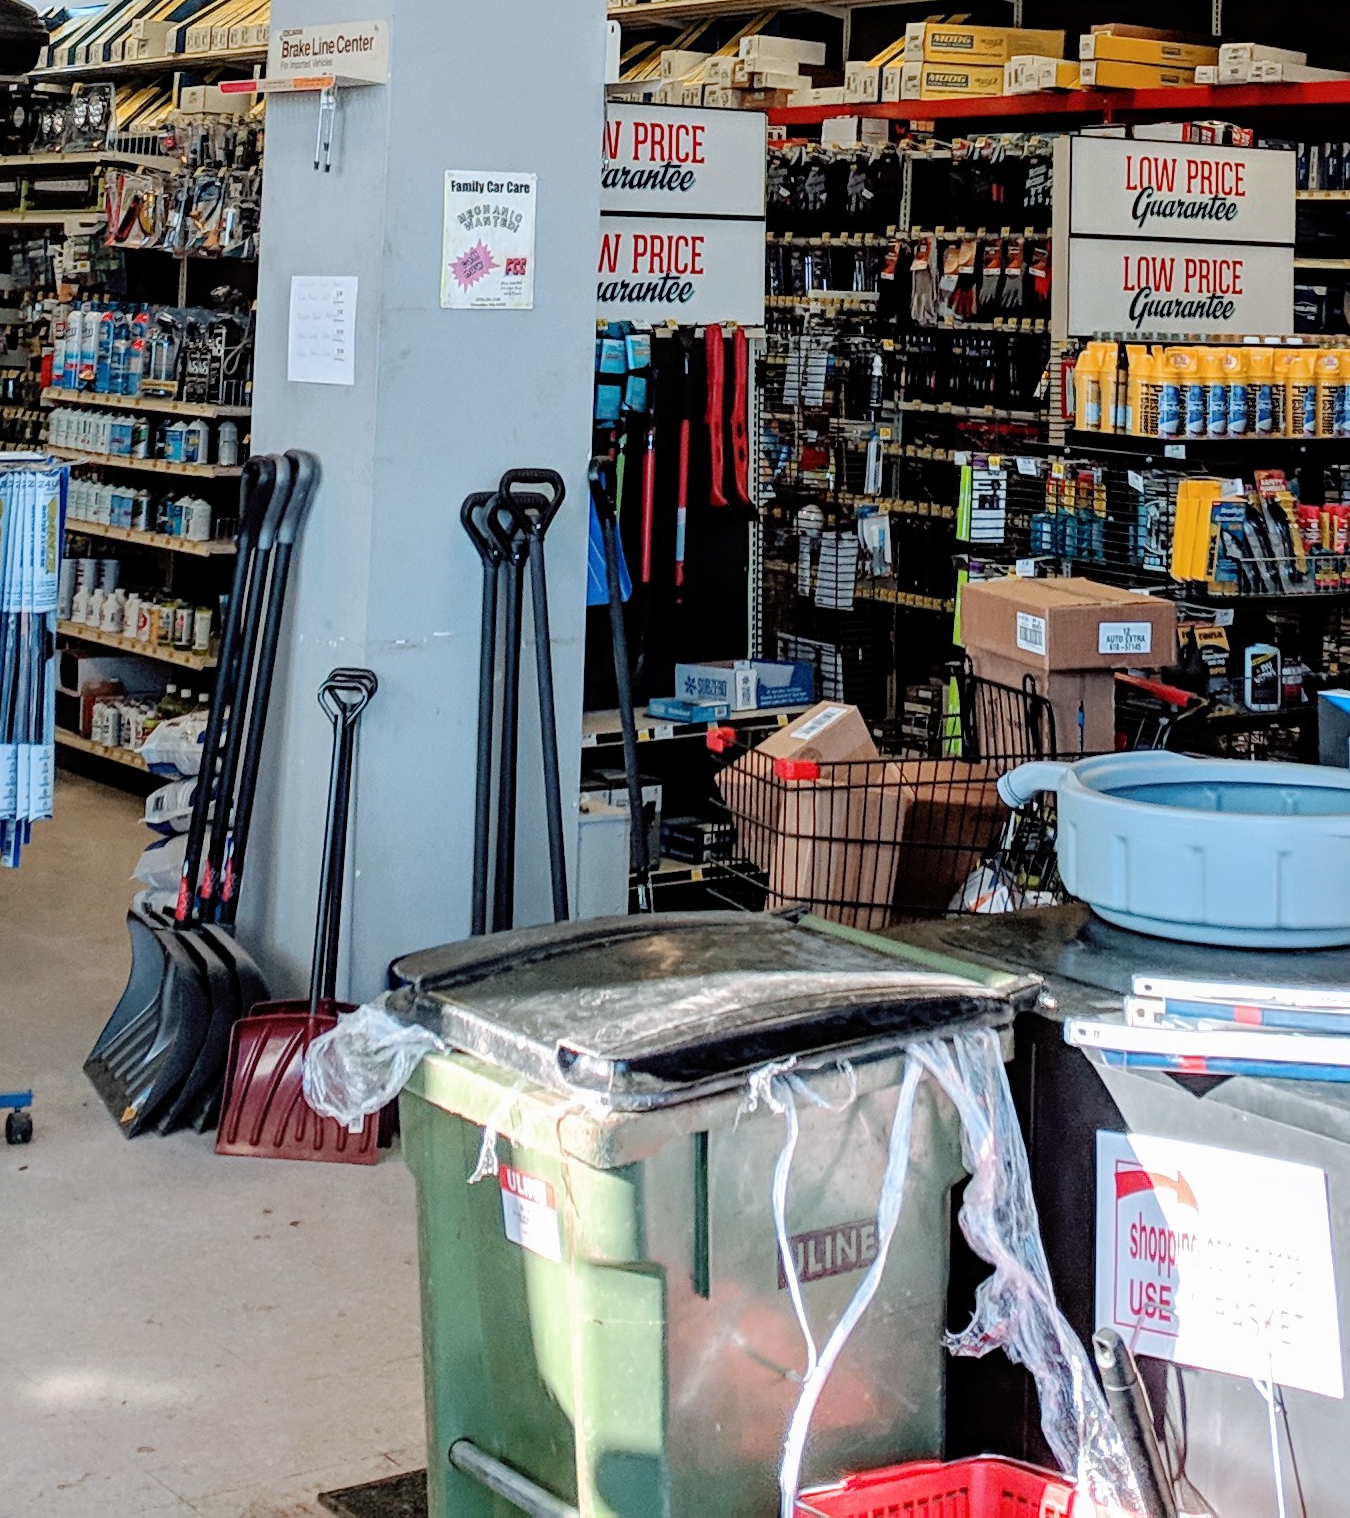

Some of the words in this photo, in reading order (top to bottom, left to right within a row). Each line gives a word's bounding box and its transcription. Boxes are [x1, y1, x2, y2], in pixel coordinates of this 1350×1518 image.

[282, 39, 311, 59] Brake
[312, 37, 335, 56] Line
[337, 34, 375, 54] Center
[632, 121, 706, 164] PRICE
[451, 180, 485, 194] Family
[487, 180, 504, 193] Car
[506, 181, 531, 194] Care
[601, 161, 696, 192] arantee
[1125, 155, 1178, 193] LOW
[1186, 159, 1247, 197] PRICE
[1131, 185, 1239, 229] Guarantee
[631, 234, 705, 275] PRICE
[597, 271, 695, 303] arantee
[1123, 256, 1176, 293] LOW
[1183, 258, 1244, 296] PRICE
[1128, 286, 1236, 330] Guarantee
[1129, 1278, 1172, 1323] USE
